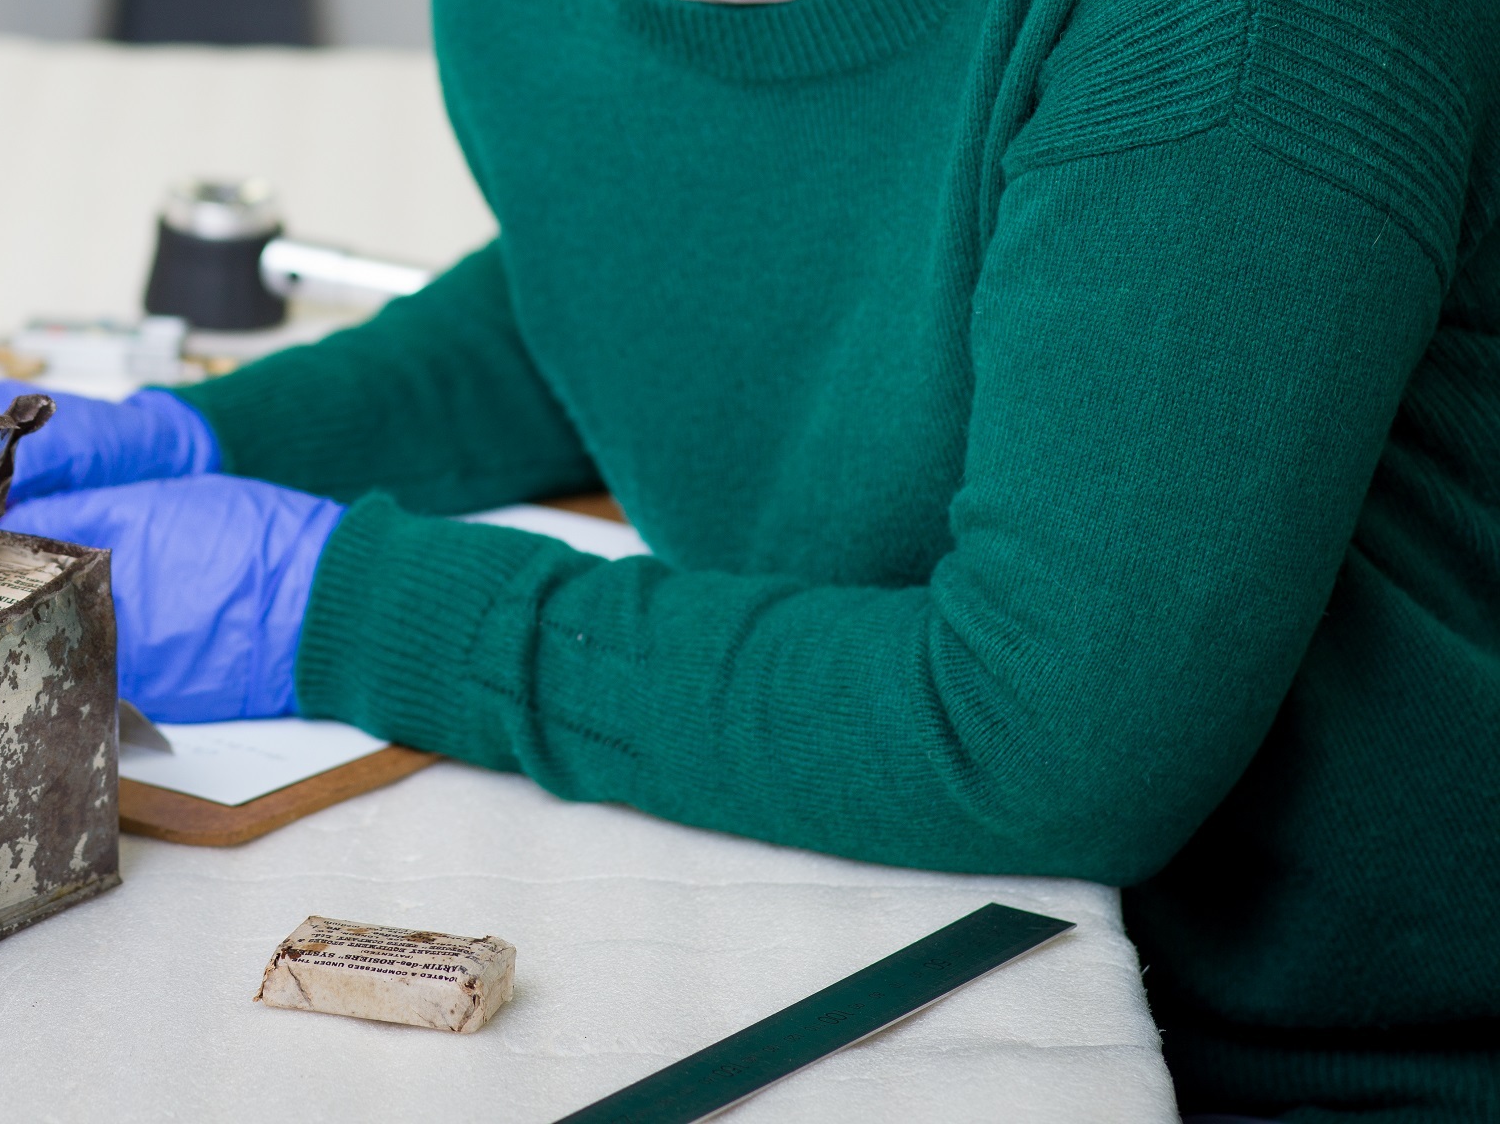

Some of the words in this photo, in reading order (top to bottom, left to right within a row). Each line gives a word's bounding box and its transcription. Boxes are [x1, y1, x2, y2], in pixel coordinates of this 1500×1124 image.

[308, 938, 345, 946] STORES
[347, 942, 406, 953] EQUIPMENT
[409, 948, 461, 957] MILITARY
[314, 959, 345, 968] UNDER
[923, 958, 952, 970] 50
[347, 963, 408, 976] COMPRESSED
[818, 1009, 855, 1025] 100
